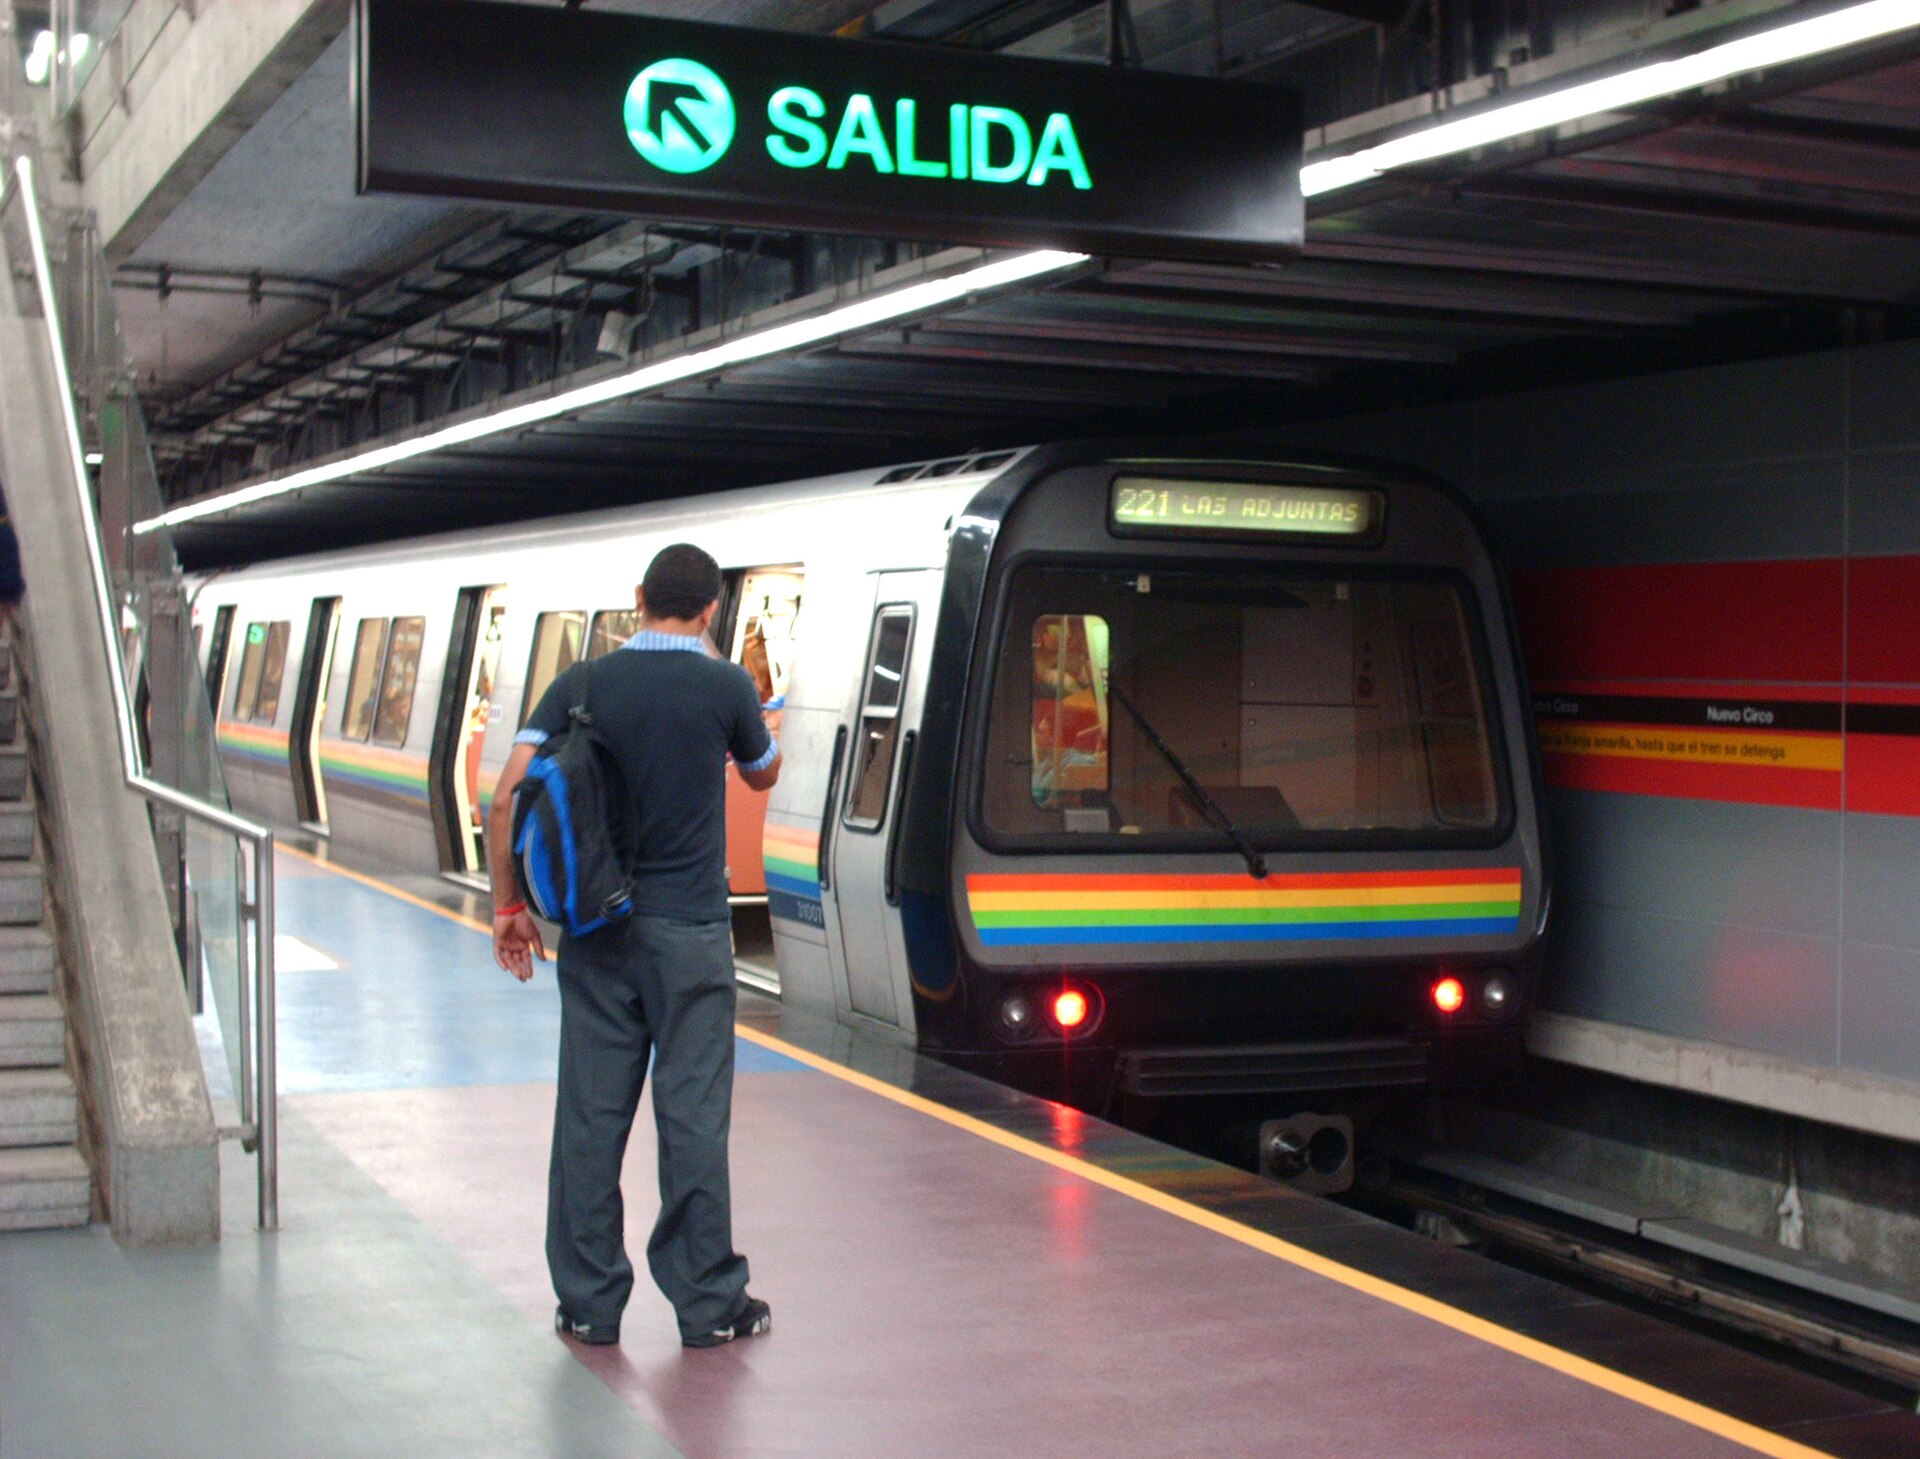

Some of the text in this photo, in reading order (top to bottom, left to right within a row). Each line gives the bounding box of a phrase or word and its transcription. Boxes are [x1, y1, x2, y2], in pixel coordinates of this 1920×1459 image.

[765, 85, 1093, 190] SALIDA
[1115, 488, 1360, 522] 221 LAS ADJUNTAS
[1706, 705, 1774, 725] Nuevo Circo
[1635, 737, 1664, 752] hasta
[1667, 741, 1686, 756] que
[1688, 740, 1697, 753] el
[1699, 741, 1722, 754] tren
[1724, 743, 1737, 755] se
[1740, 742, 1786, 761] detenga
